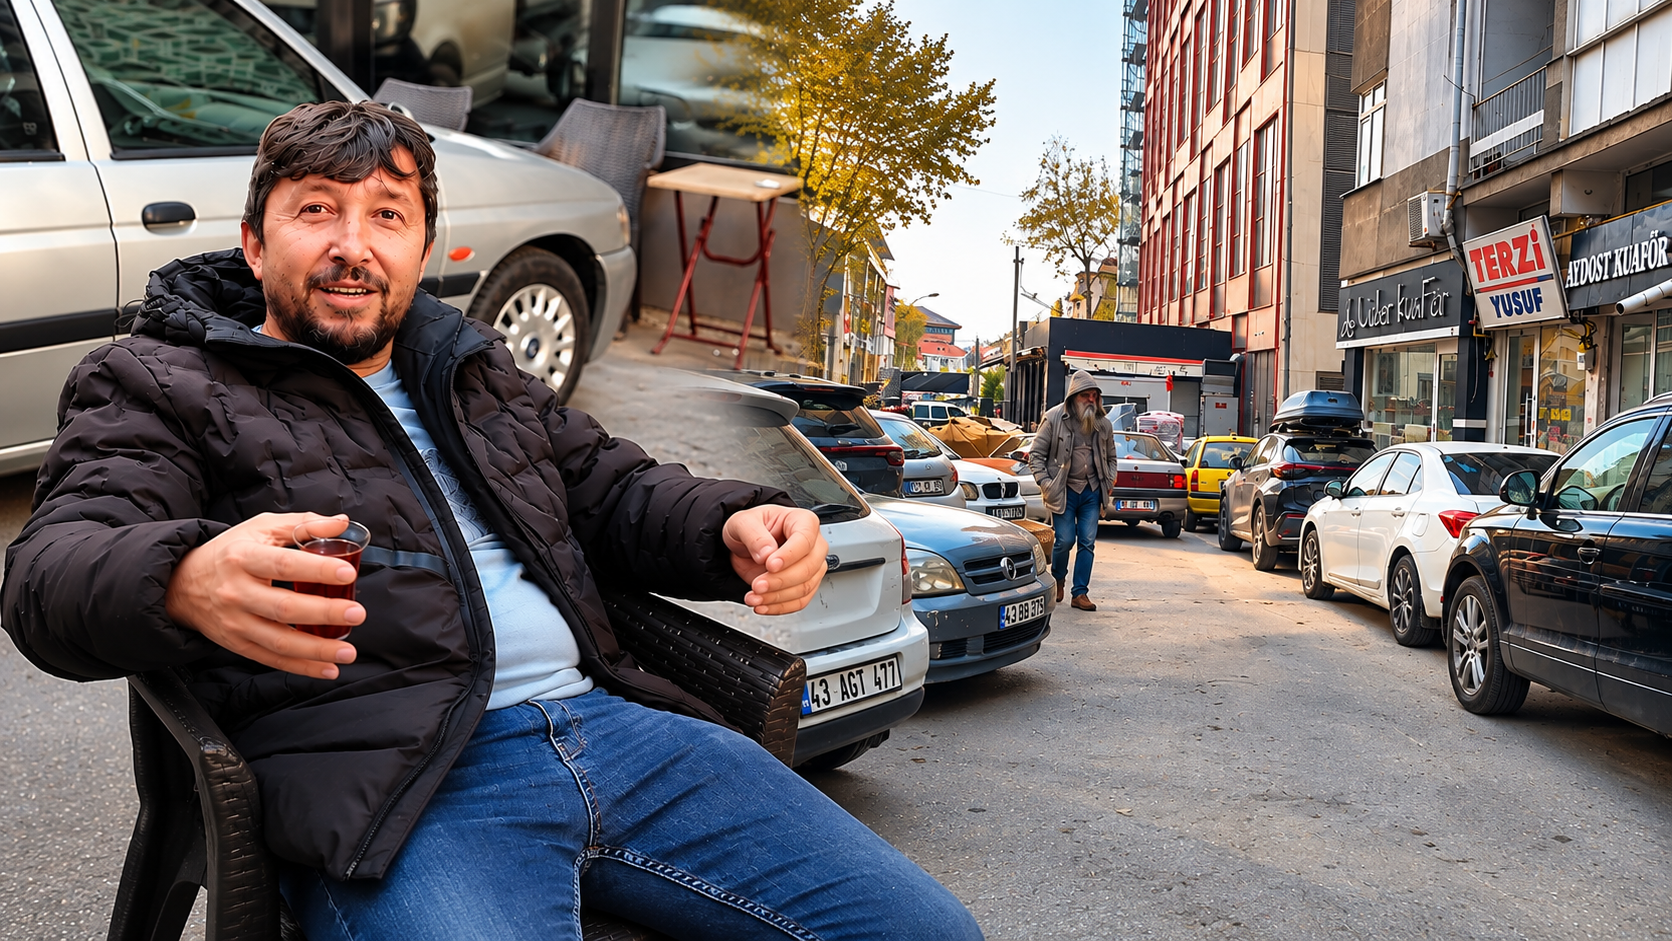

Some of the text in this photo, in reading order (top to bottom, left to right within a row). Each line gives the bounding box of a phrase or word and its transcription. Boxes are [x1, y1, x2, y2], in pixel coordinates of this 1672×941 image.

[1565, 230, 1669, 289] AYDOST KUAFÖR
[1489, 287, 1543, 319] YUSUF
[1005, 605, 1017, 624] 43
[811, 660, 895, 708] 43 AGT 477
